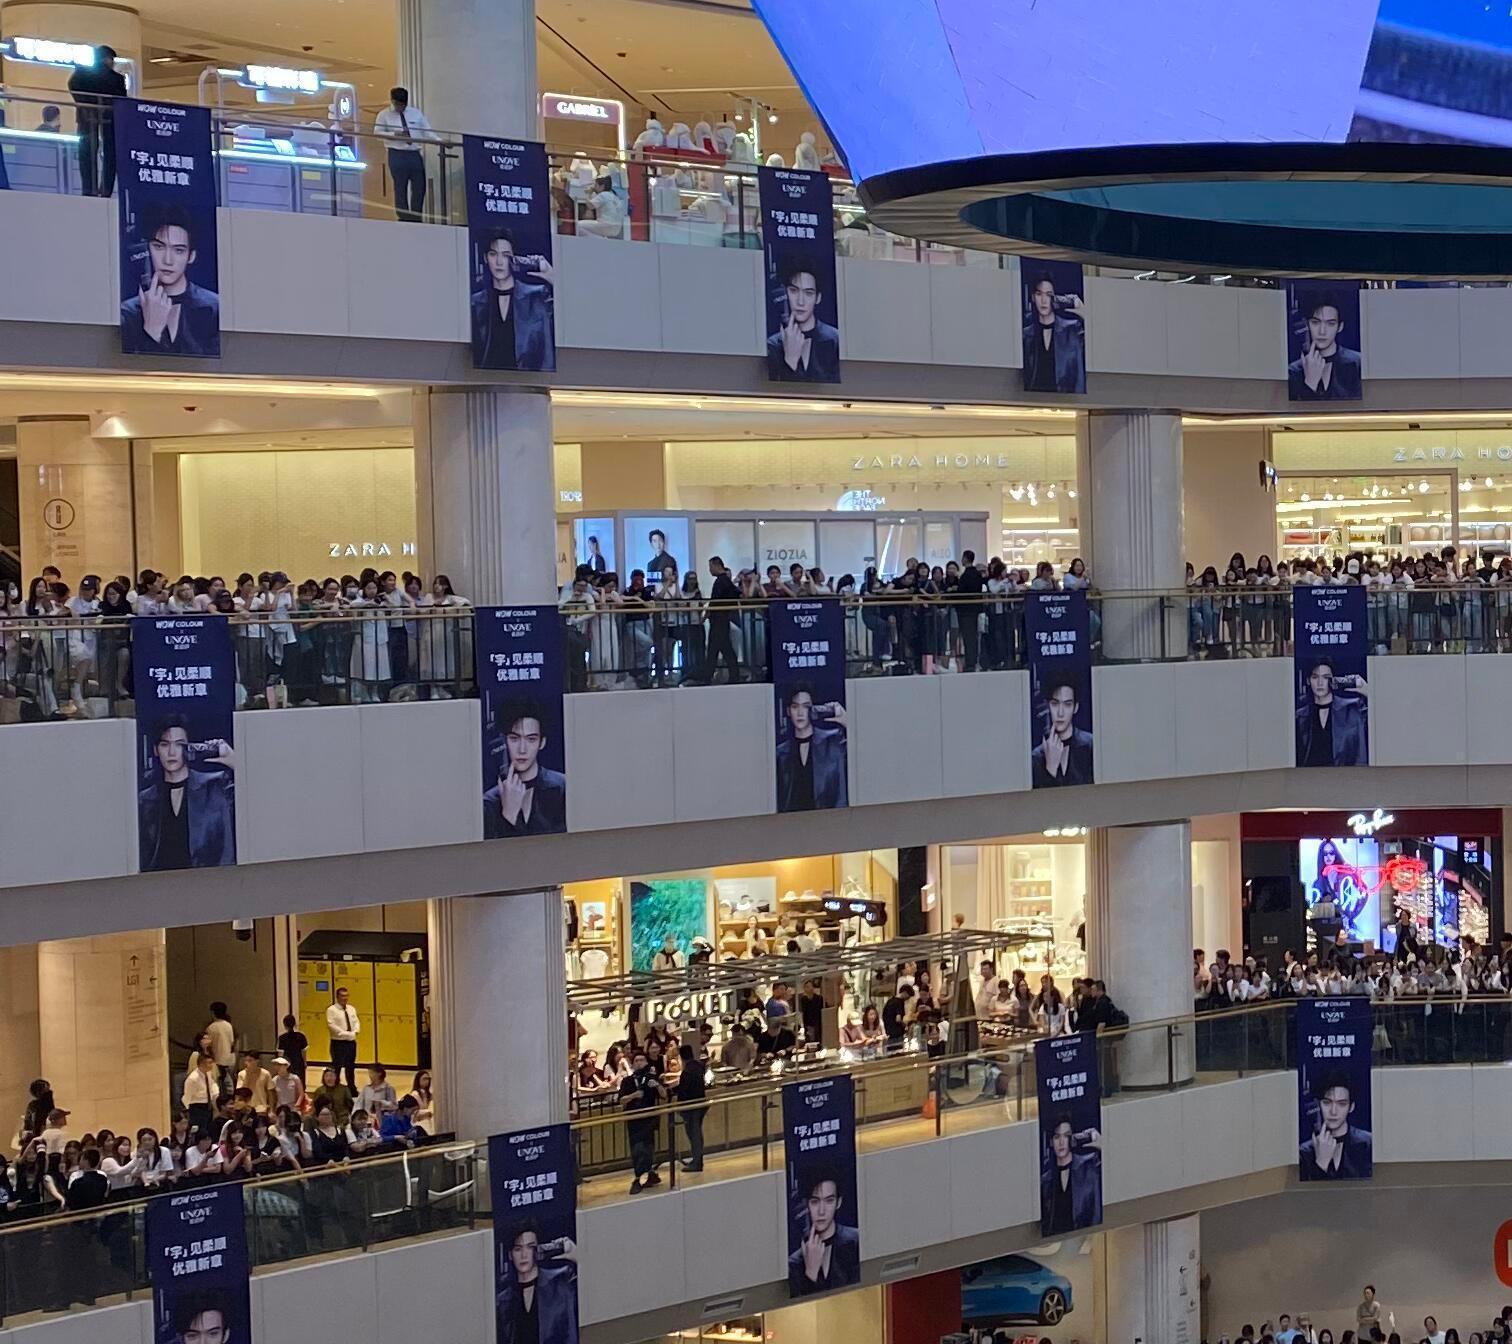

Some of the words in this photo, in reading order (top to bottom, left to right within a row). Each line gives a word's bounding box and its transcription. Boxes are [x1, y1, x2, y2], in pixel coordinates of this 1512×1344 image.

[556, 101, 609, 118] GABRIEL
[852, 454, 922, 471] ZARA
[935, 452, 1009, 470] HOME
[1392, 447, 1465, 463] ZARA
[329, 542, 391, 557] ZARA
